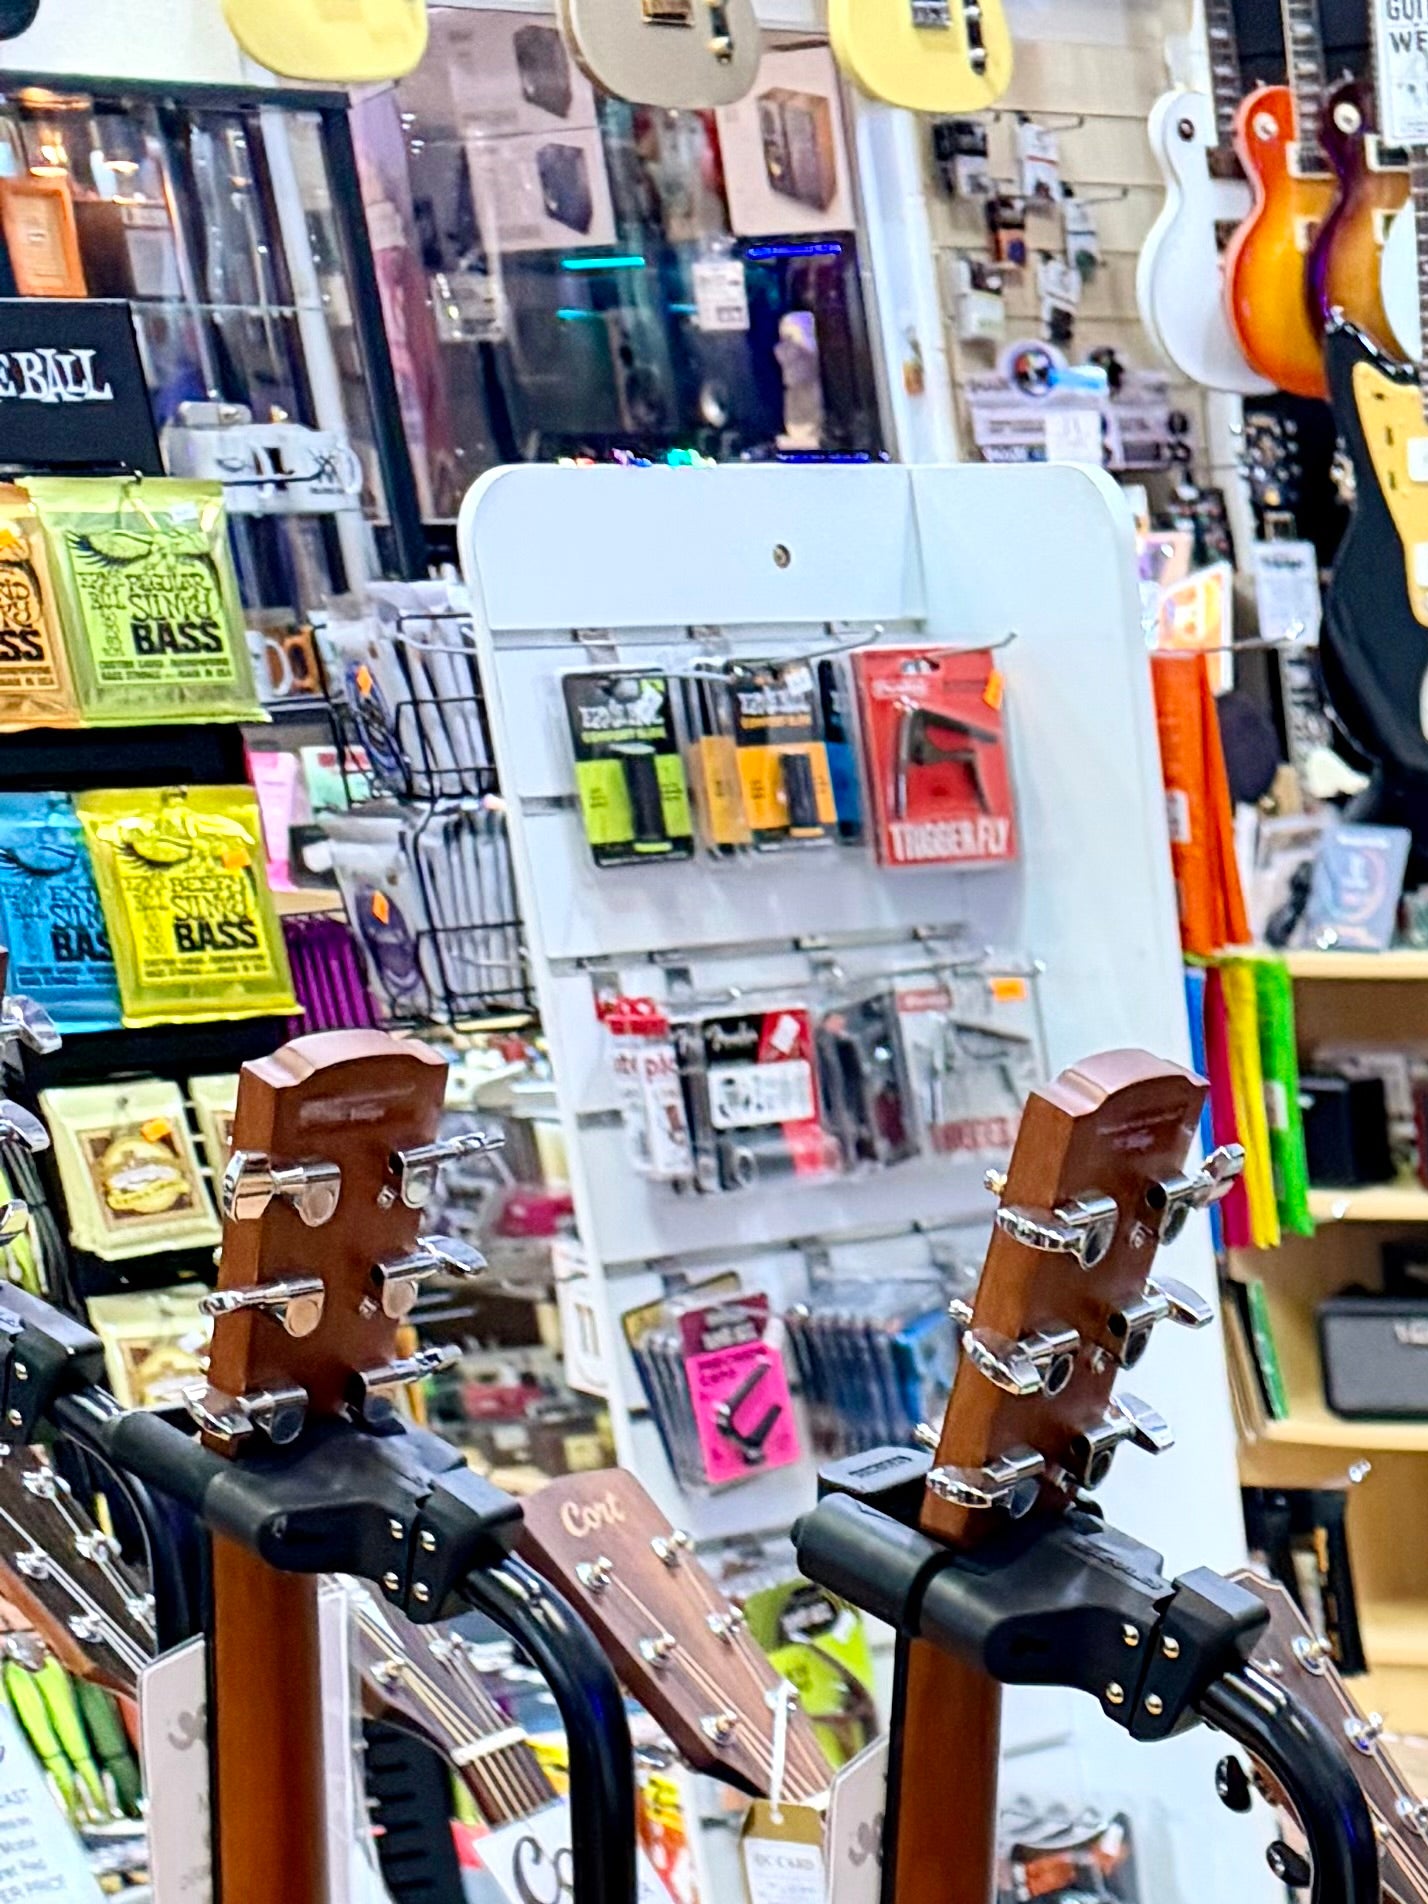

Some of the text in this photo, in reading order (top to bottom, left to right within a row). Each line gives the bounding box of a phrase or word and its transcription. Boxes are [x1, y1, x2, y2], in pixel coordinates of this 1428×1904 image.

[20, 348, 114, 402] BALL
[126, 572, 209, 595] REGULAR
[129, 591, 218, 624] SLINKY
[0, 629, 45, 661] SS
[132, 620, 224, 655] BASS
[888, 818, 1011, 861] TRIGGER FLY
[50, 885, 98, 903] EXT
[52, 923, 114, 963] BAS
[174, 918, 258, 952] BASS
[561, 1490, 627, 1538] Cort
